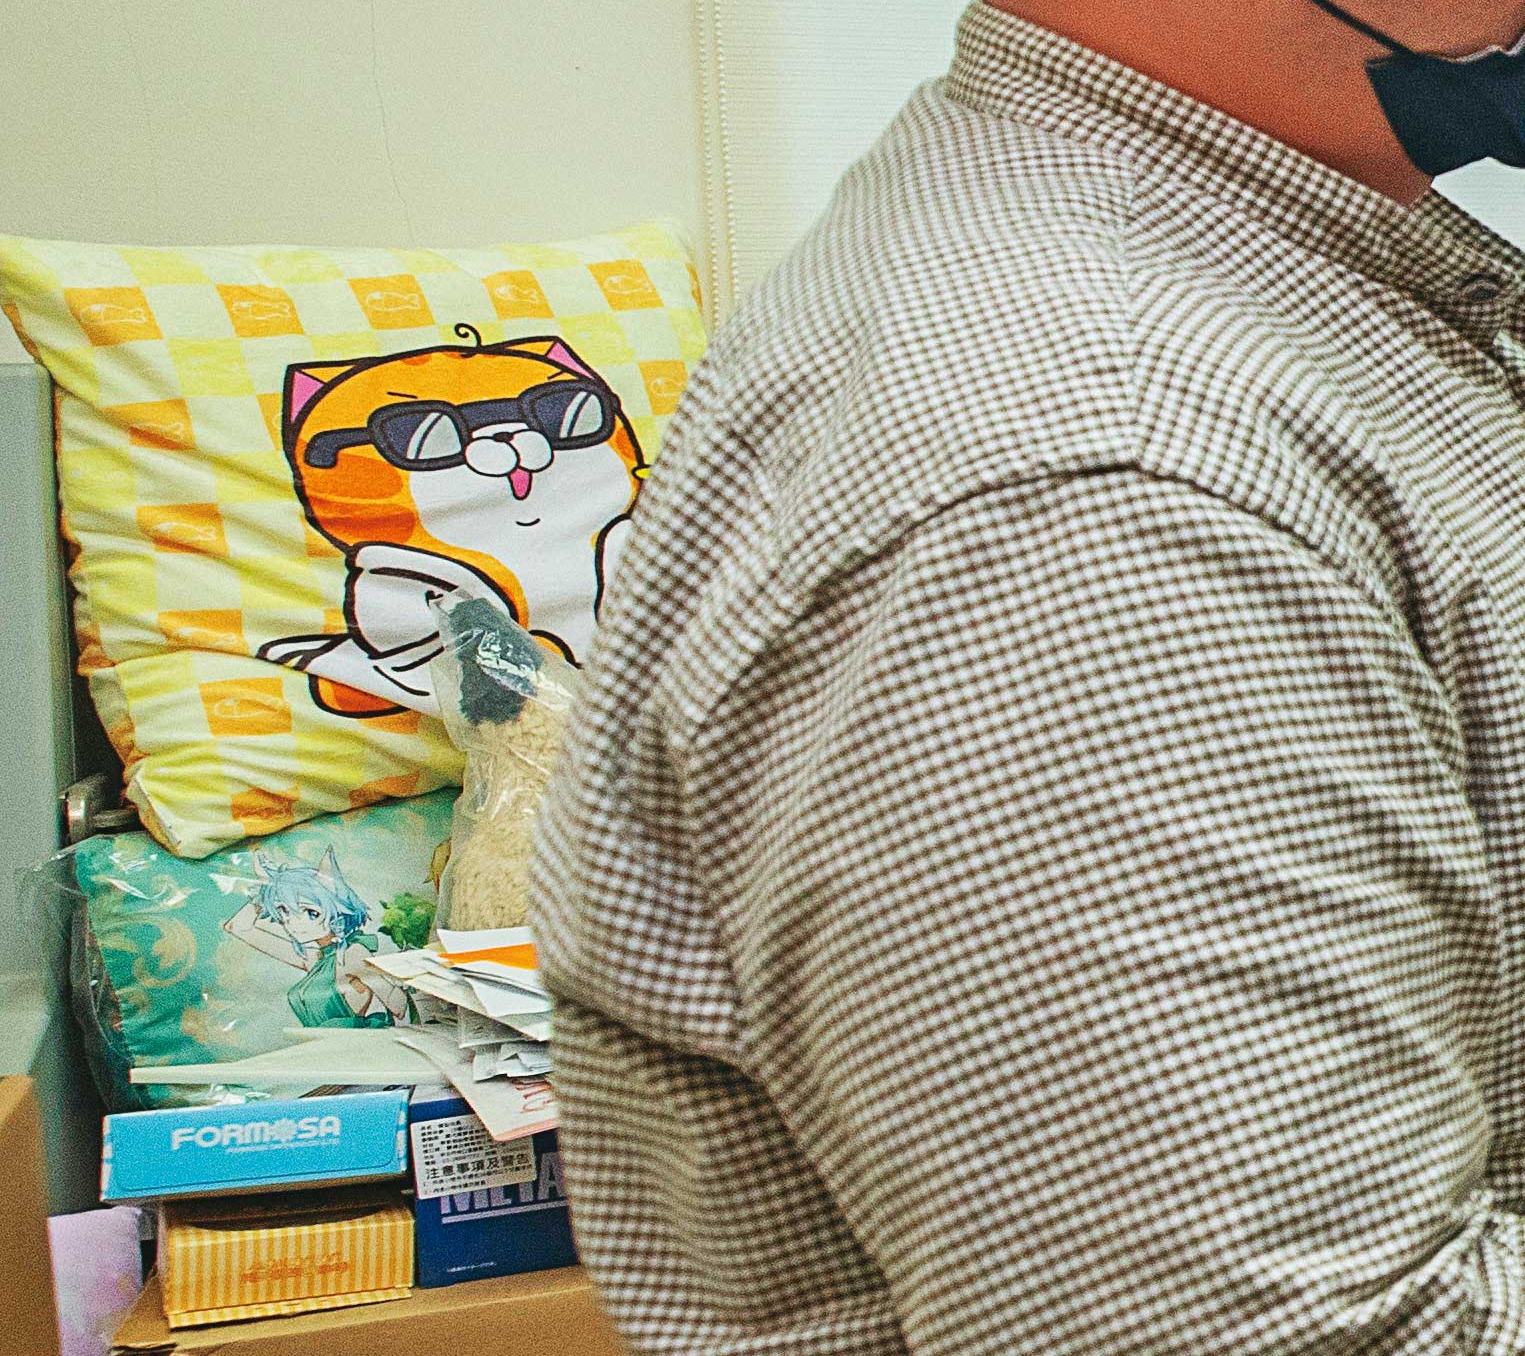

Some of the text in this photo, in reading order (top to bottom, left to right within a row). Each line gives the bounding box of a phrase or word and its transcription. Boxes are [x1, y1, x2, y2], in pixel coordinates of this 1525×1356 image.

[171, 1116, 341, 1151] FORMOSA
[426, 1153, 530, 1180] 注意事項及警告
